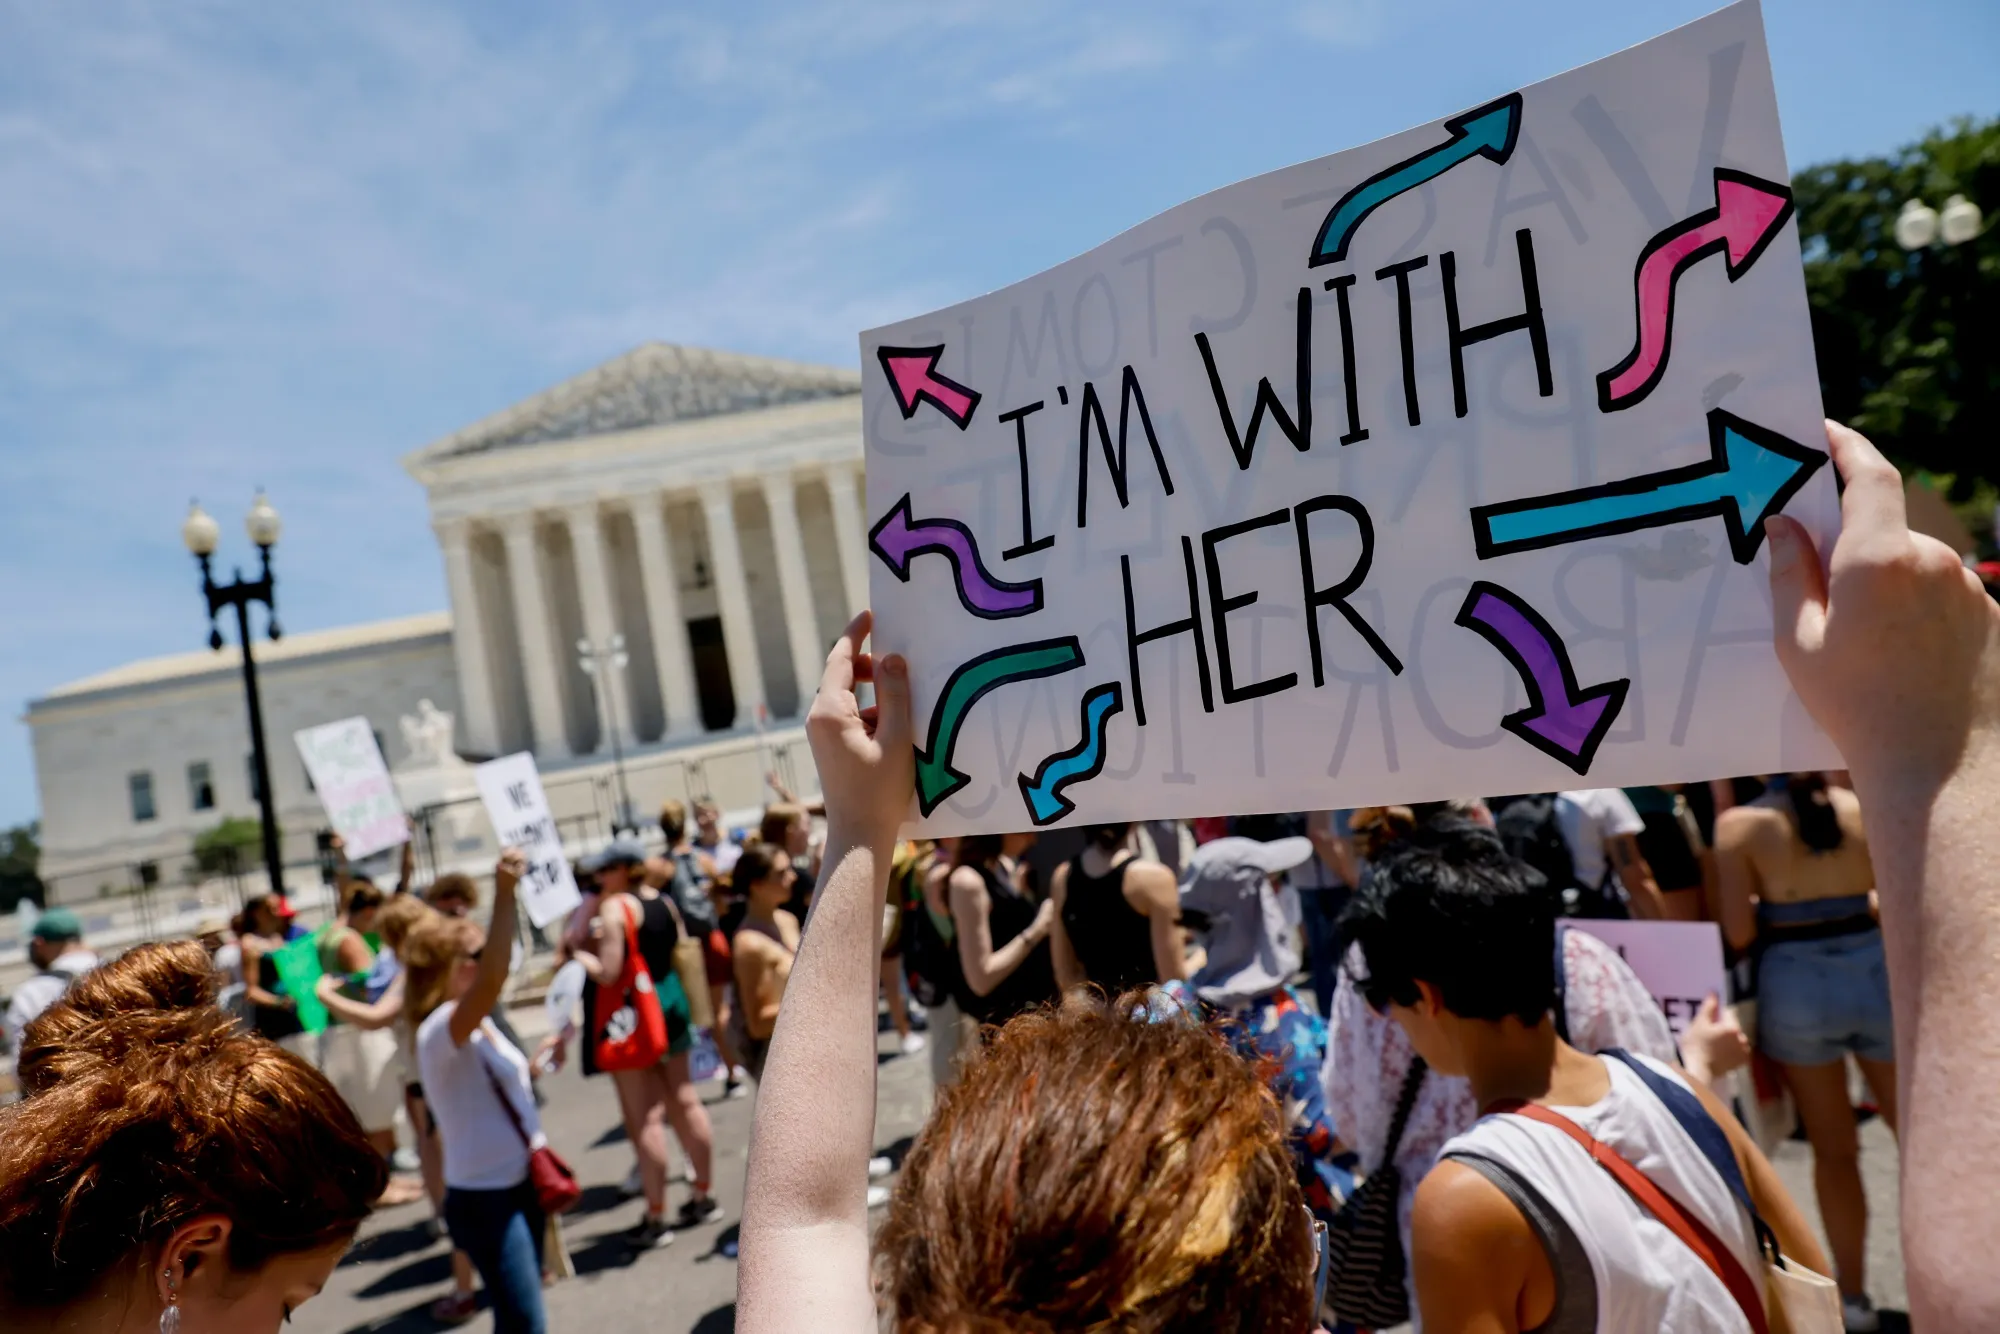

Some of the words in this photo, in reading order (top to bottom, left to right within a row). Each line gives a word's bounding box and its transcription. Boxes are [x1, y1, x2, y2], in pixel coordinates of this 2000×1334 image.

[998, 364, 1175, 562] I'M
[1194, 227, 1554, 470] WITH
[1121, 493, 1404, 727] HER
